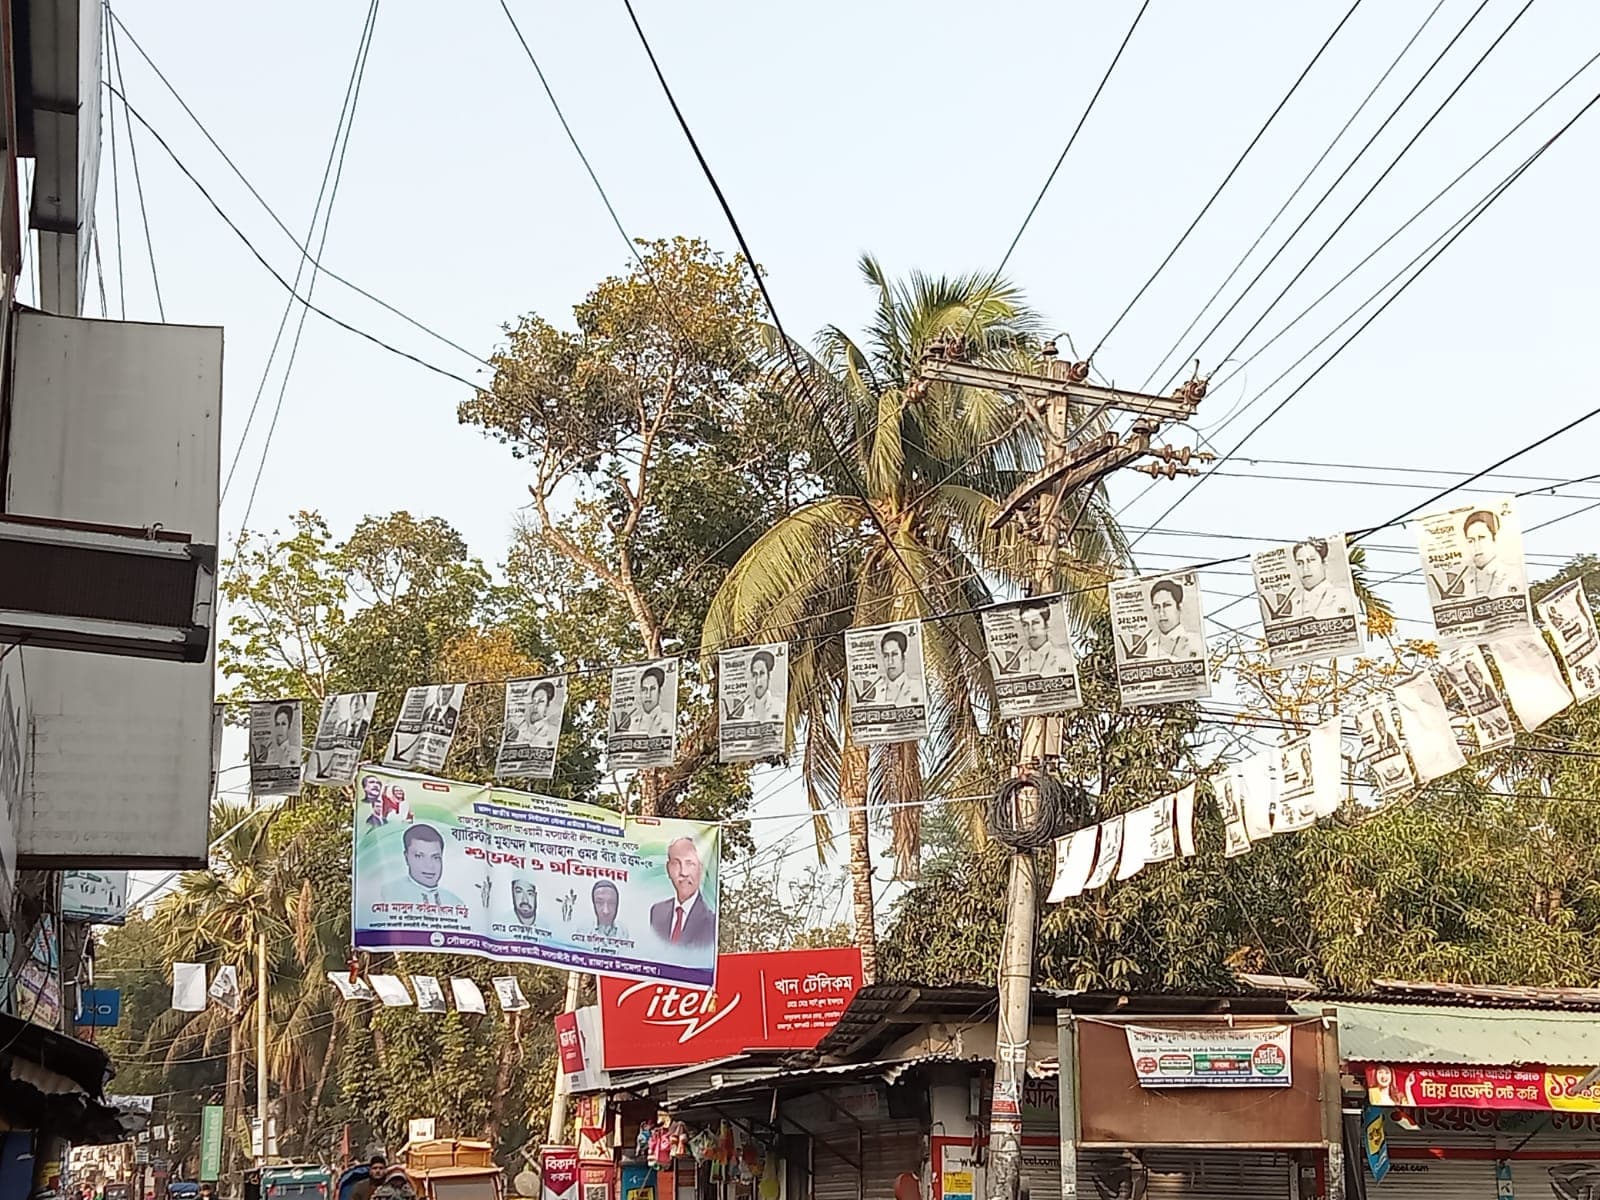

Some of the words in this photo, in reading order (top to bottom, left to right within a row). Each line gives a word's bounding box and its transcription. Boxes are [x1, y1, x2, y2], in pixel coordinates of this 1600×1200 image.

[451, 828, 492, 845] ব্যারিস্টার
[529, 841, 574, 857] শাহজাহান
[578, 847, 598, 861] ওমর
[464, 846, 525, 869] শুভেচ্ছা
[531, 858, 544, 871] ও
[550, 858, 629, 882] অভিনন্দন
[371, 902, 389, 914] মোঃ
[774, 977, 800, 995] খান
[802, 972, 854, 993] টেলিকম
[645, 985, 713, 1018] itel
[1514, 1071, 1540, 1081] করতে
[1449, 1081, 1494, 1098] এজেন্ট
[1516, 1087, 1539, 1100] করি
[545, 1156, 577, 1171] বিকাশ
